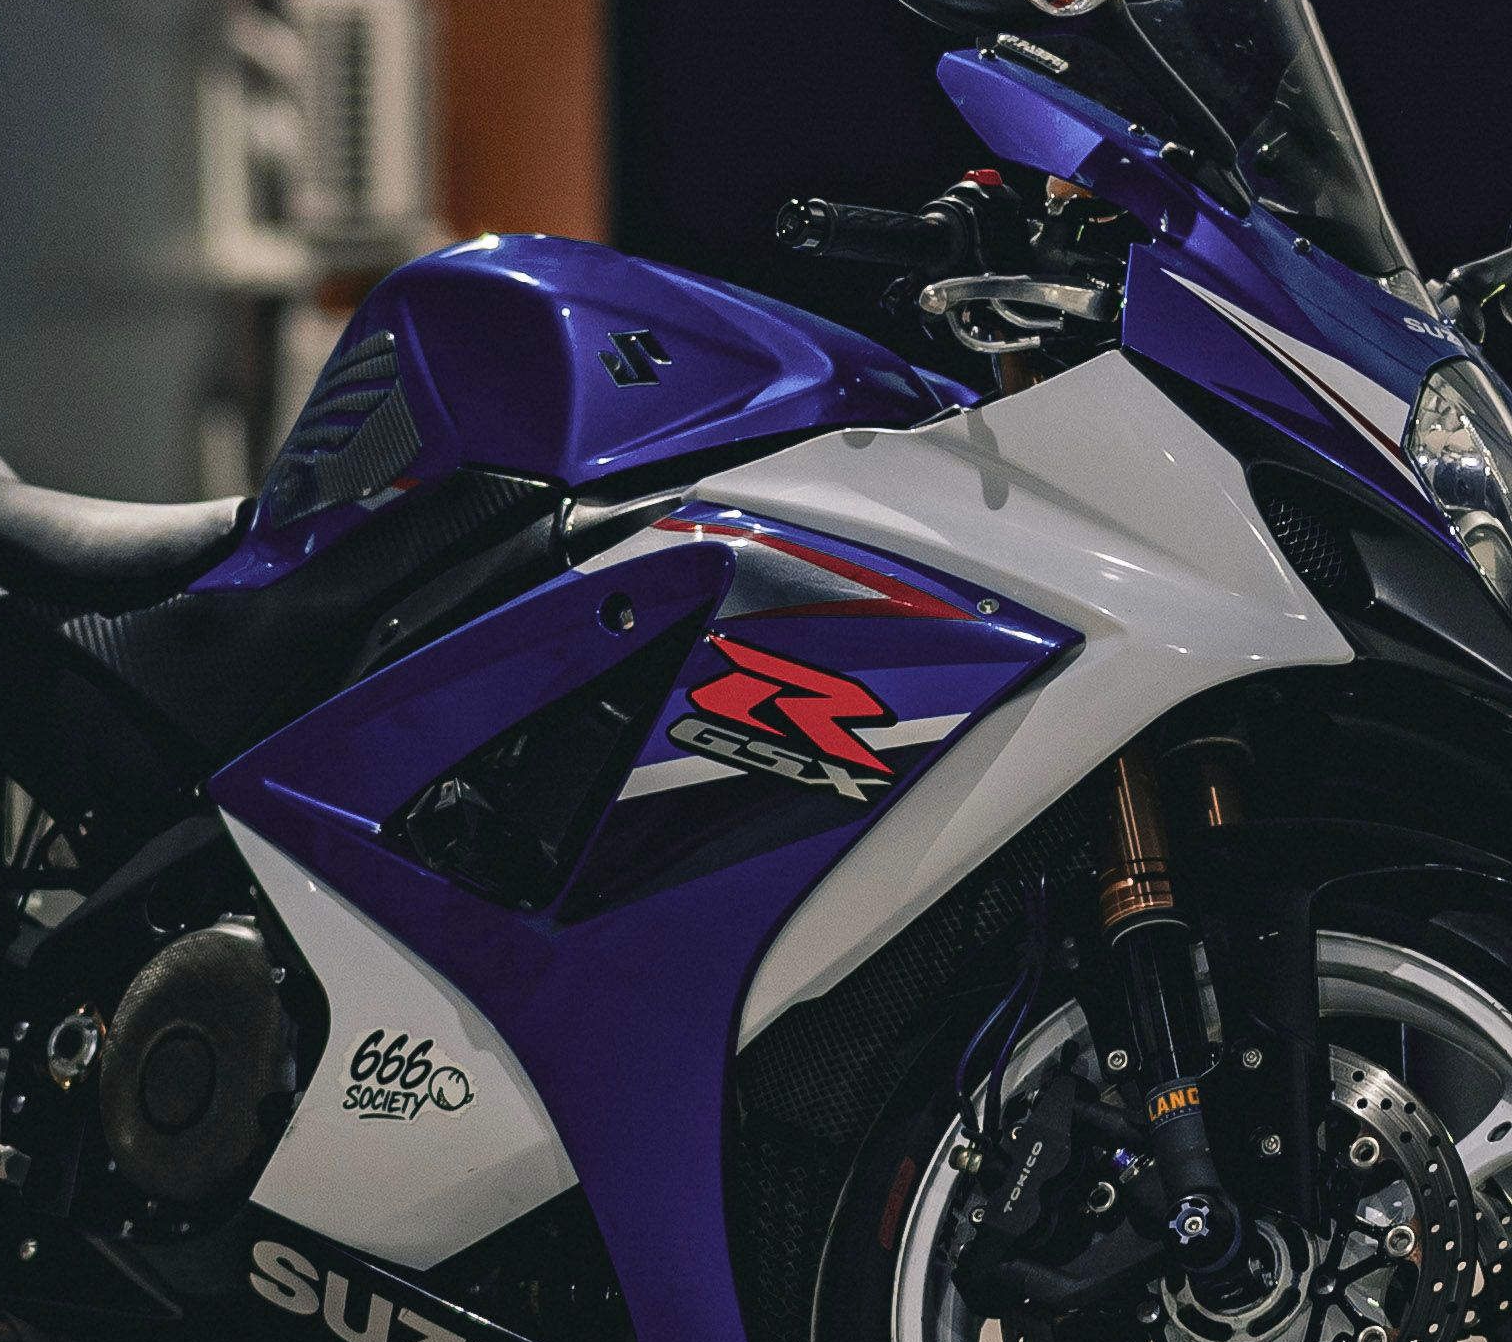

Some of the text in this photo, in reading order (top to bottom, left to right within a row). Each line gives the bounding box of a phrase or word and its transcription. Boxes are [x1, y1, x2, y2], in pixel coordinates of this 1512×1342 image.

[350, 1029, 434, 1089] 666
[342, 1084, 429, 1120] SOCIETY
[1003, 1141, 1043, 1213] TOKICO
